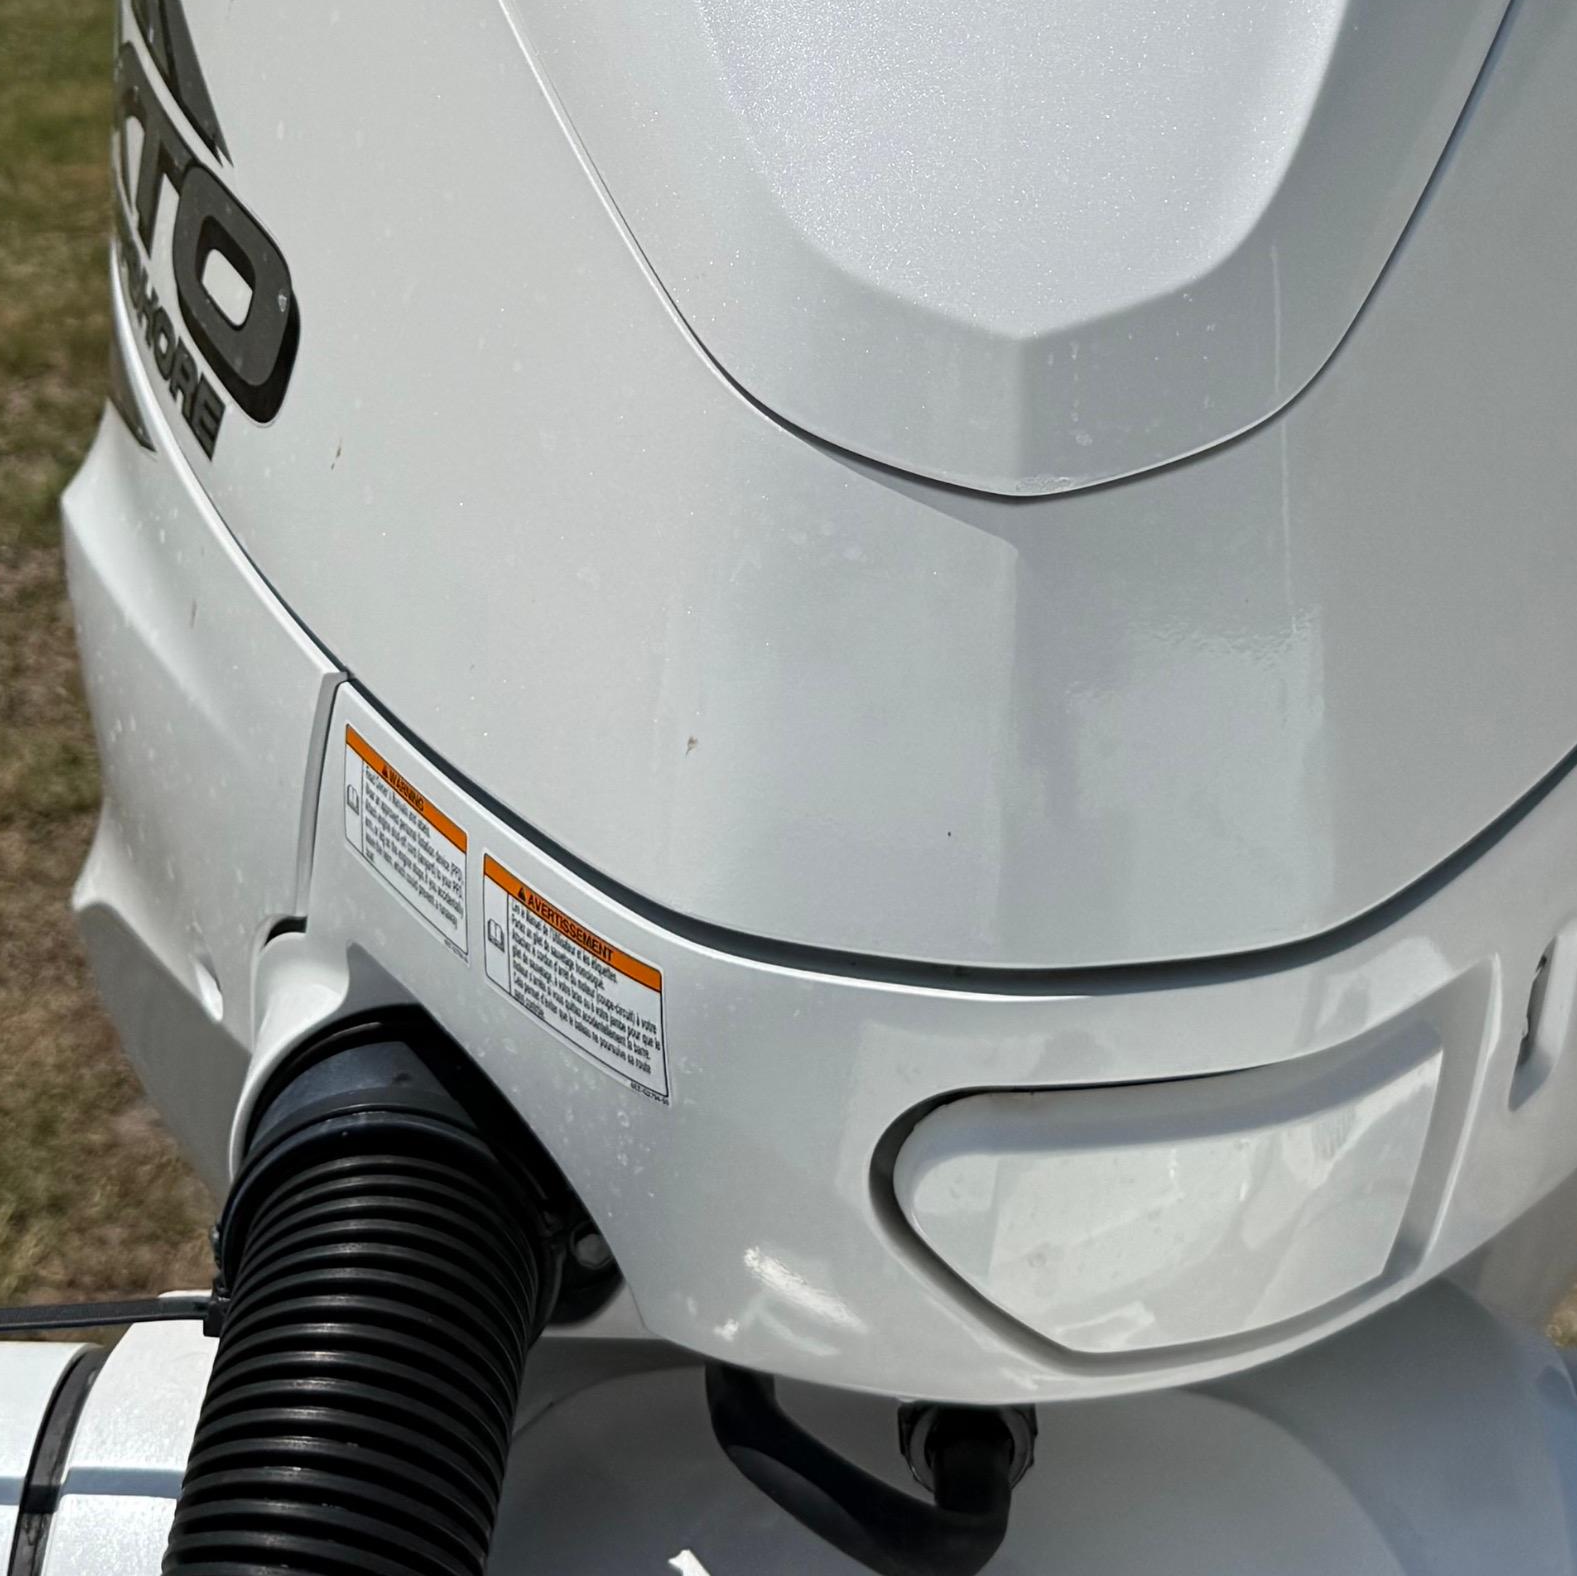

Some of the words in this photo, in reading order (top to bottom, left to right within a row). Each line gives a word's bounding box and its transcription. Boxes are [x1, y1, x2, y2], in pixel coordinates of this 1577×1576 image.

[112, 39, 300, 427] TO
[389, 770, 424, 811] WARNING
[528, 894, 613, 961] AVERTISSEMENT
